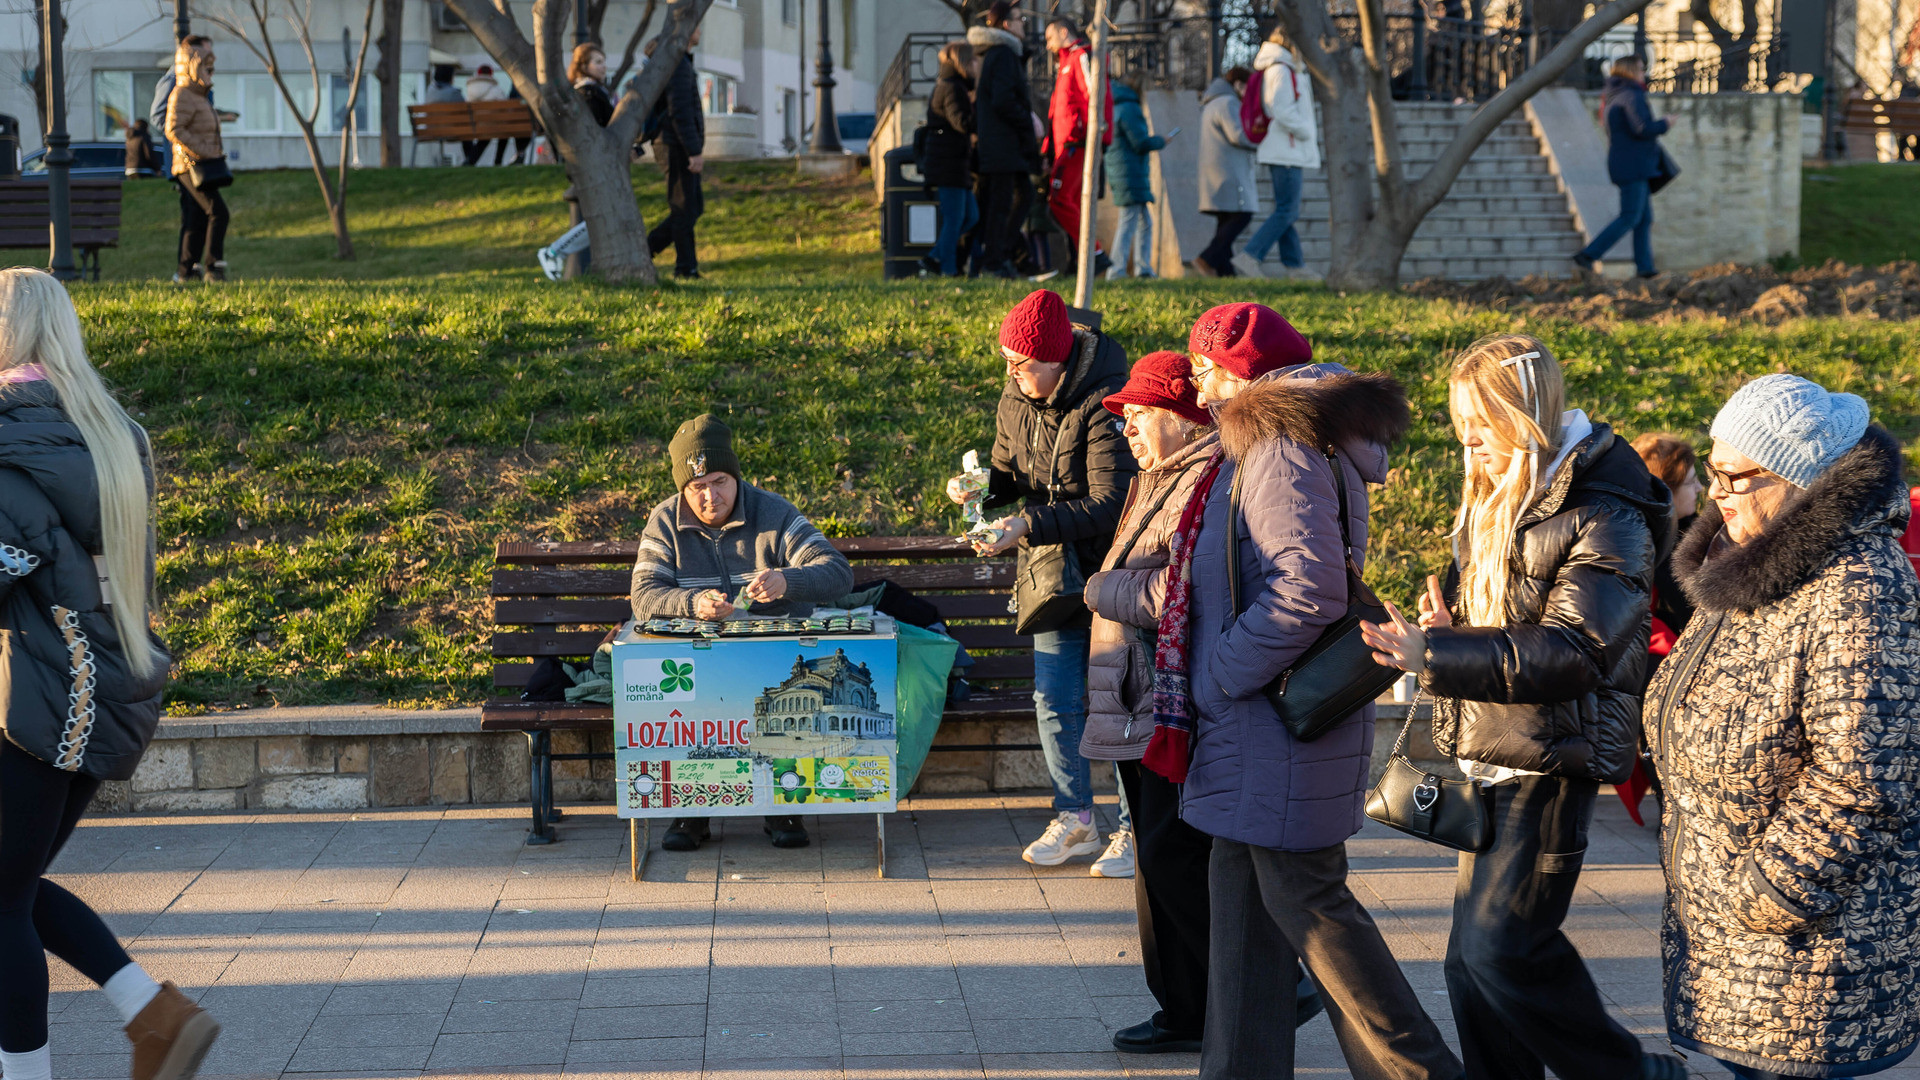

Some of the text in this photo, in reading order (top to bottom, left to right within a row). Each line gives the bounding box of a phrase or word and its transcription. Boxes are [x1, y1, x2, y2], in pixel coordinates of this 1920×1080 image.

[626, 683, 658, 692] loteria
[626, 692, 664, 701] română
[627, 708, 750, 748] LOZ ÎN PLIC
[860, 760, 878, 768] club
[852, 769, 886, 777] NOROC
